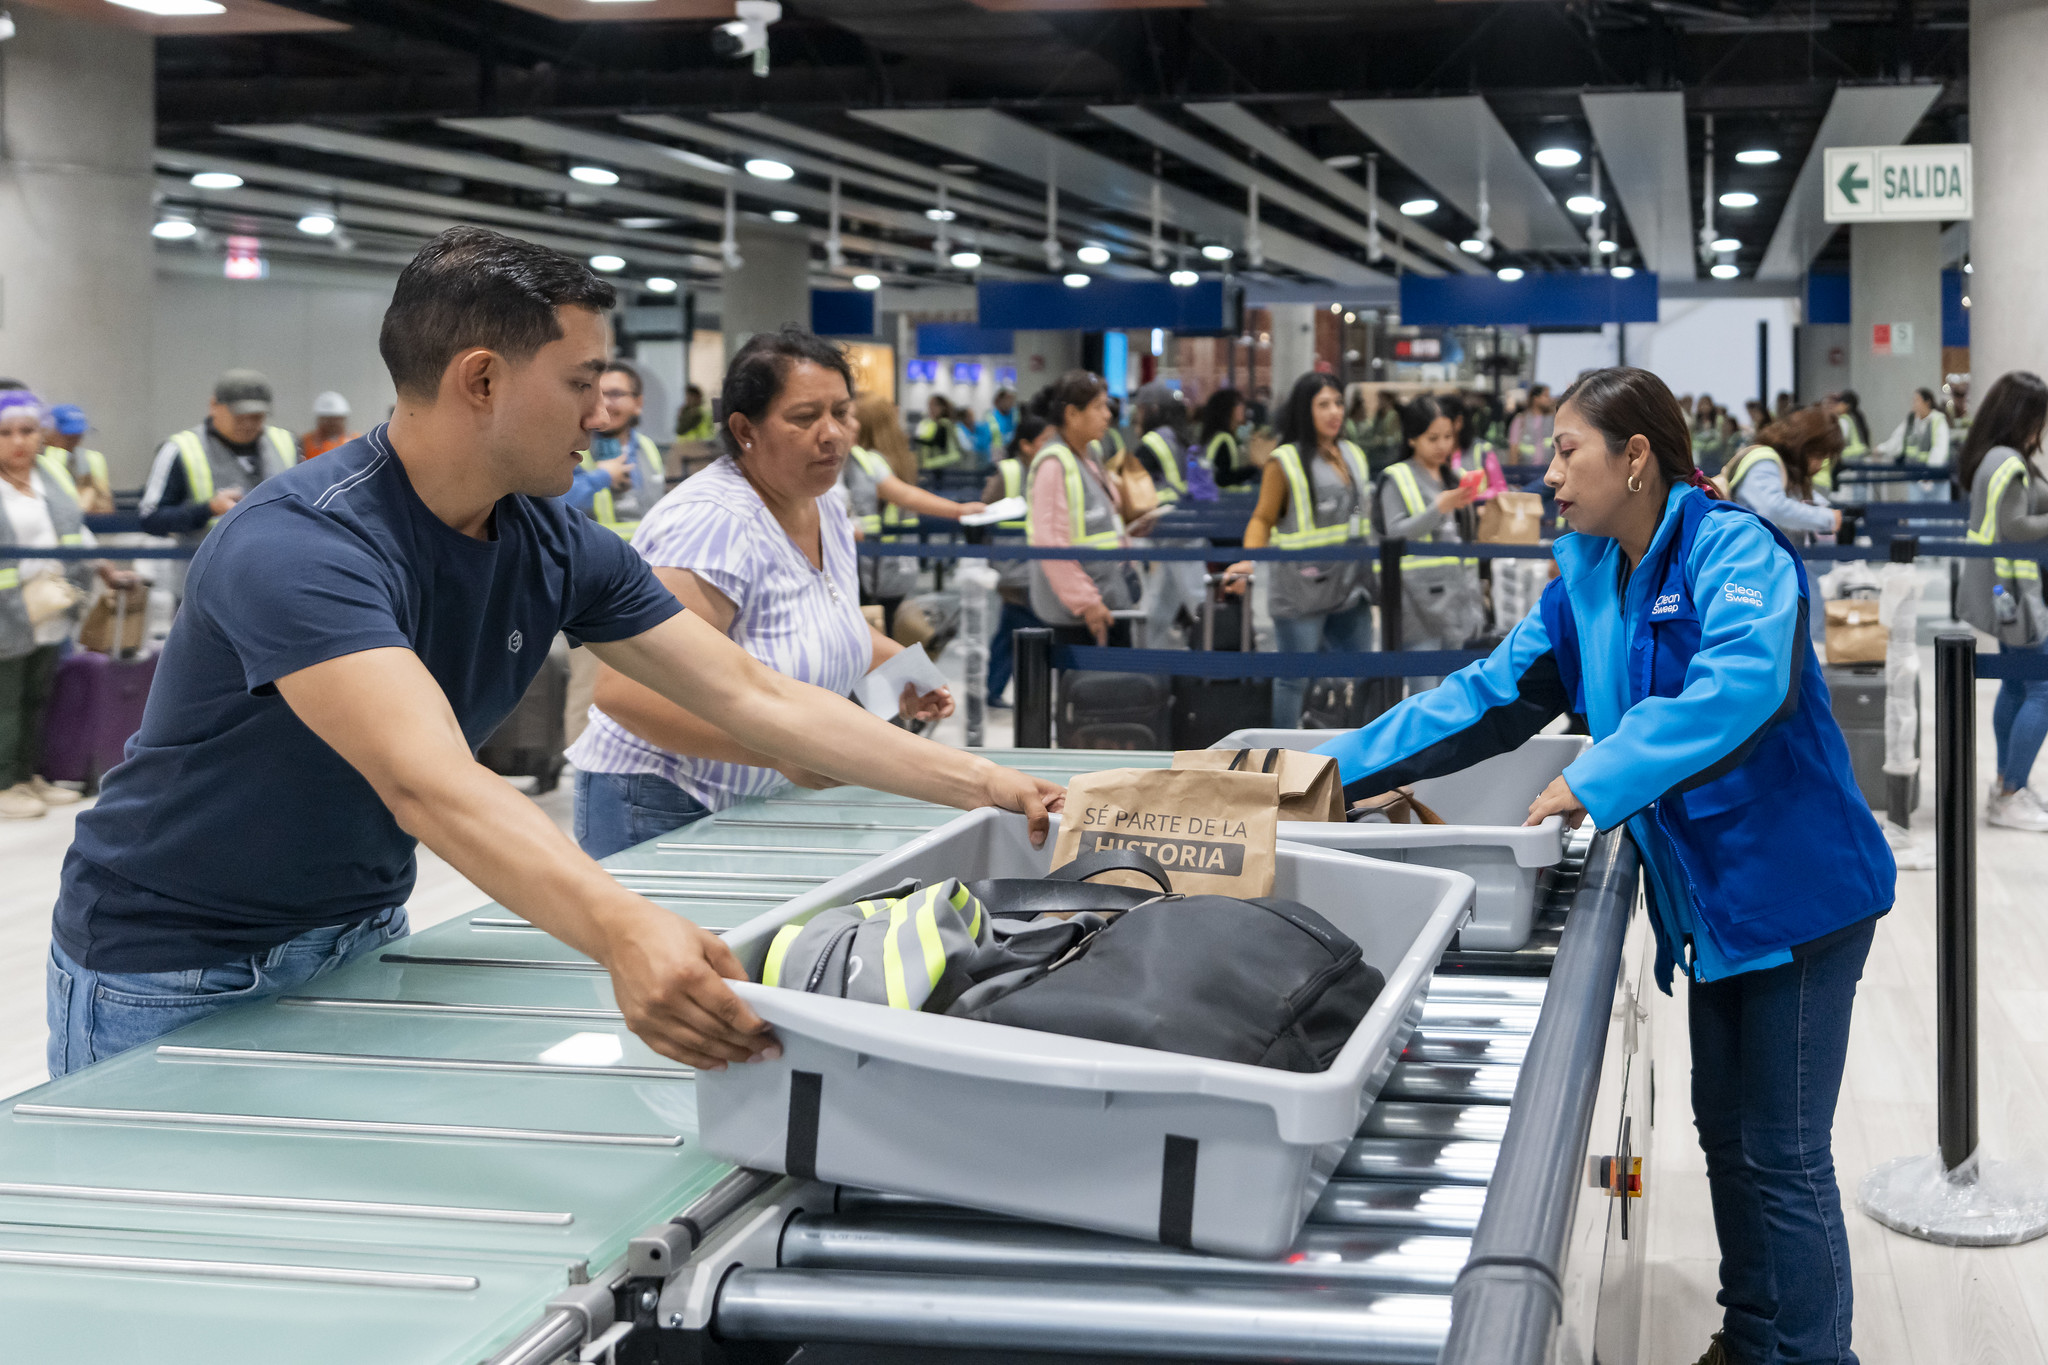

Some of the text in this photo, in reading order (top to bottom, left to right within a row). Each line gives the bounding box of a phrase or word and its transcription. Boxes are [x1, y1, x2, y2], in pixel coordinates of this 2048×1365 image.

[1884, 164, 1962, 199] SALIDA
[1724, 582, 1763, 599] Clean
[1655, 593, 1681, 606] Clean
[1725, 593, 1763, 607] Sweep
[1651, 604, 1679, 615] Sweep
[1083, 804, 1248, 839] SÉ PARTE DE LA
